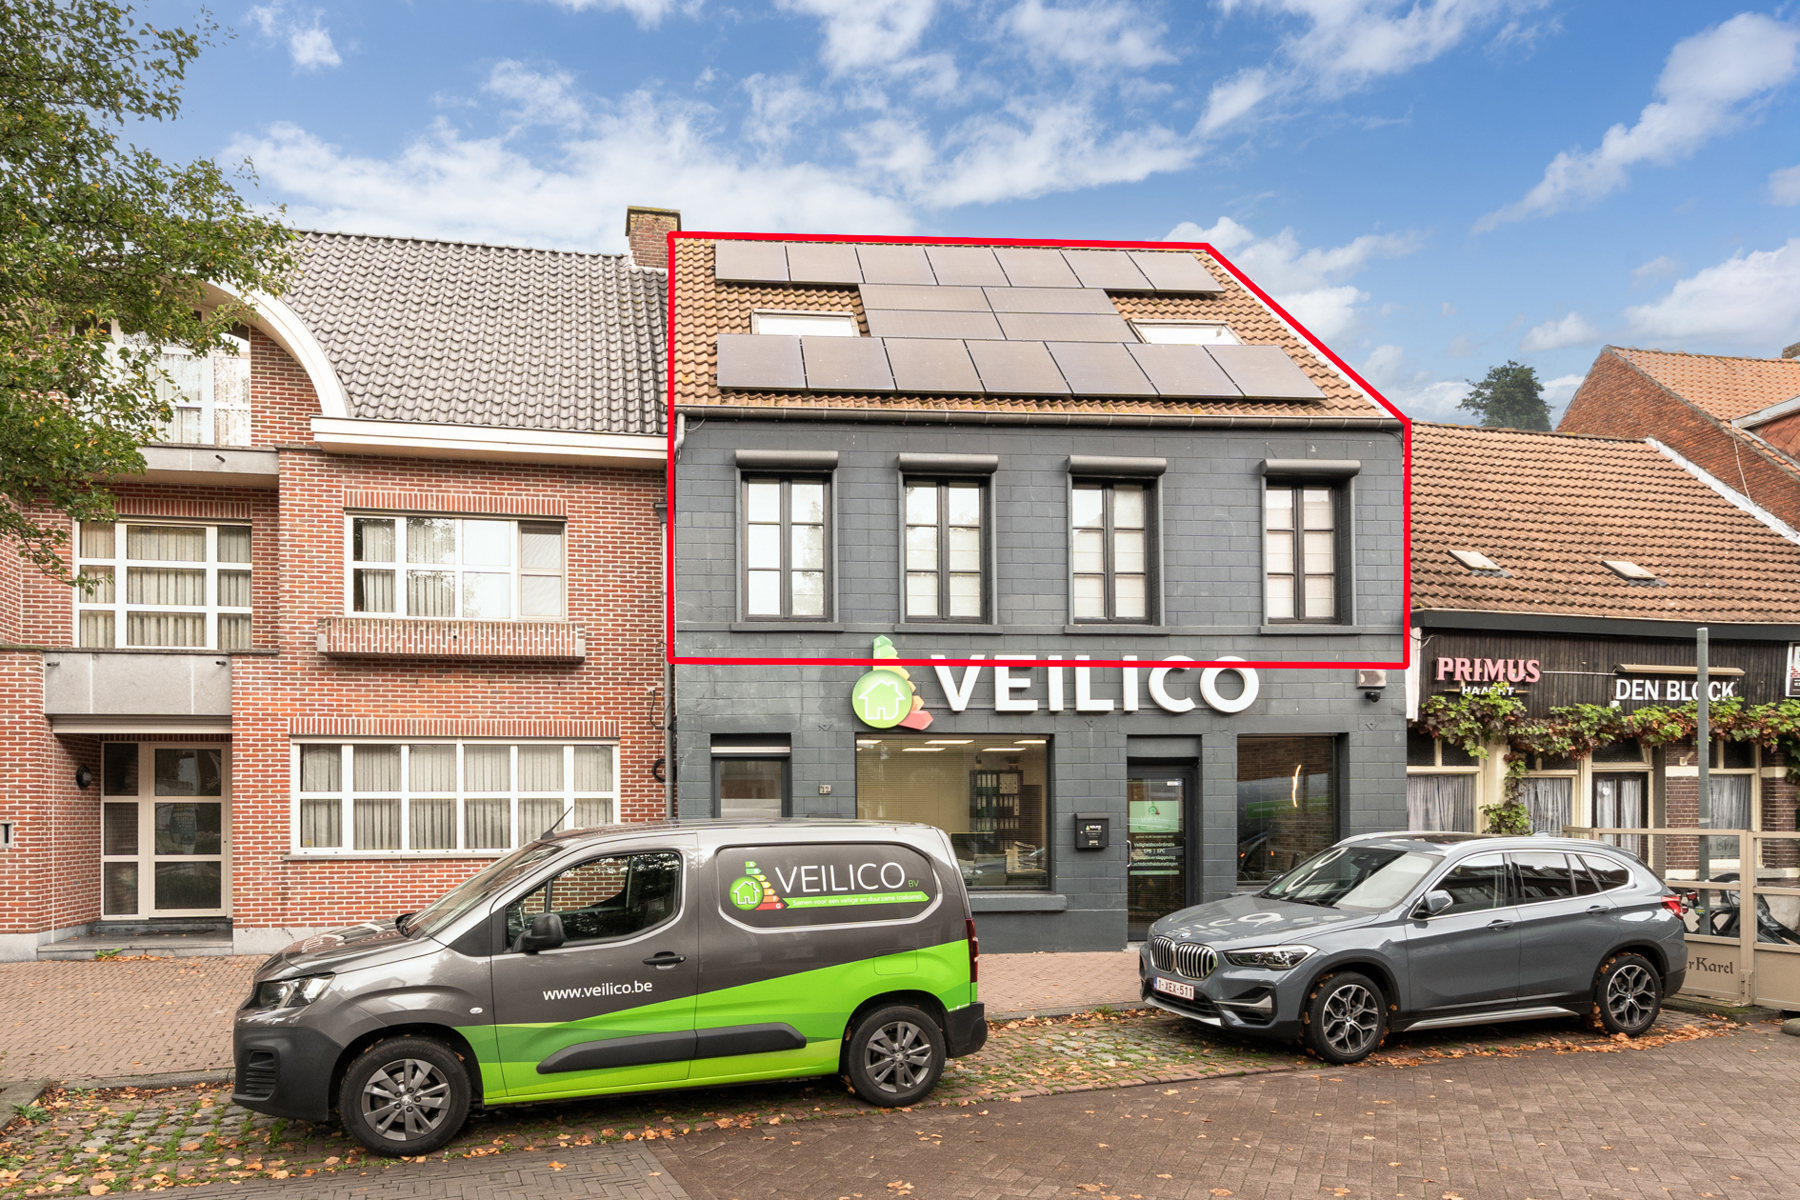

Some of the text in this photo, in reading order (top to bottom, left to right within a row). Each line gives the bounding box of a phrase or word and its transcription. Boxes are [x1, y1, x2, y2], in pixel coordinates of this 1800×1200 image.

[1436, 657, 1540, 683] PRIMUS
[930, 654, 1260, 713] VEILICO
[1616, 679, 1660, 701] DEN
[775, 862, 919, 893] VEILICO BV
[840, 897, 859, 905] veilige
[543, 980, 653, 1000] www.veilico.be
